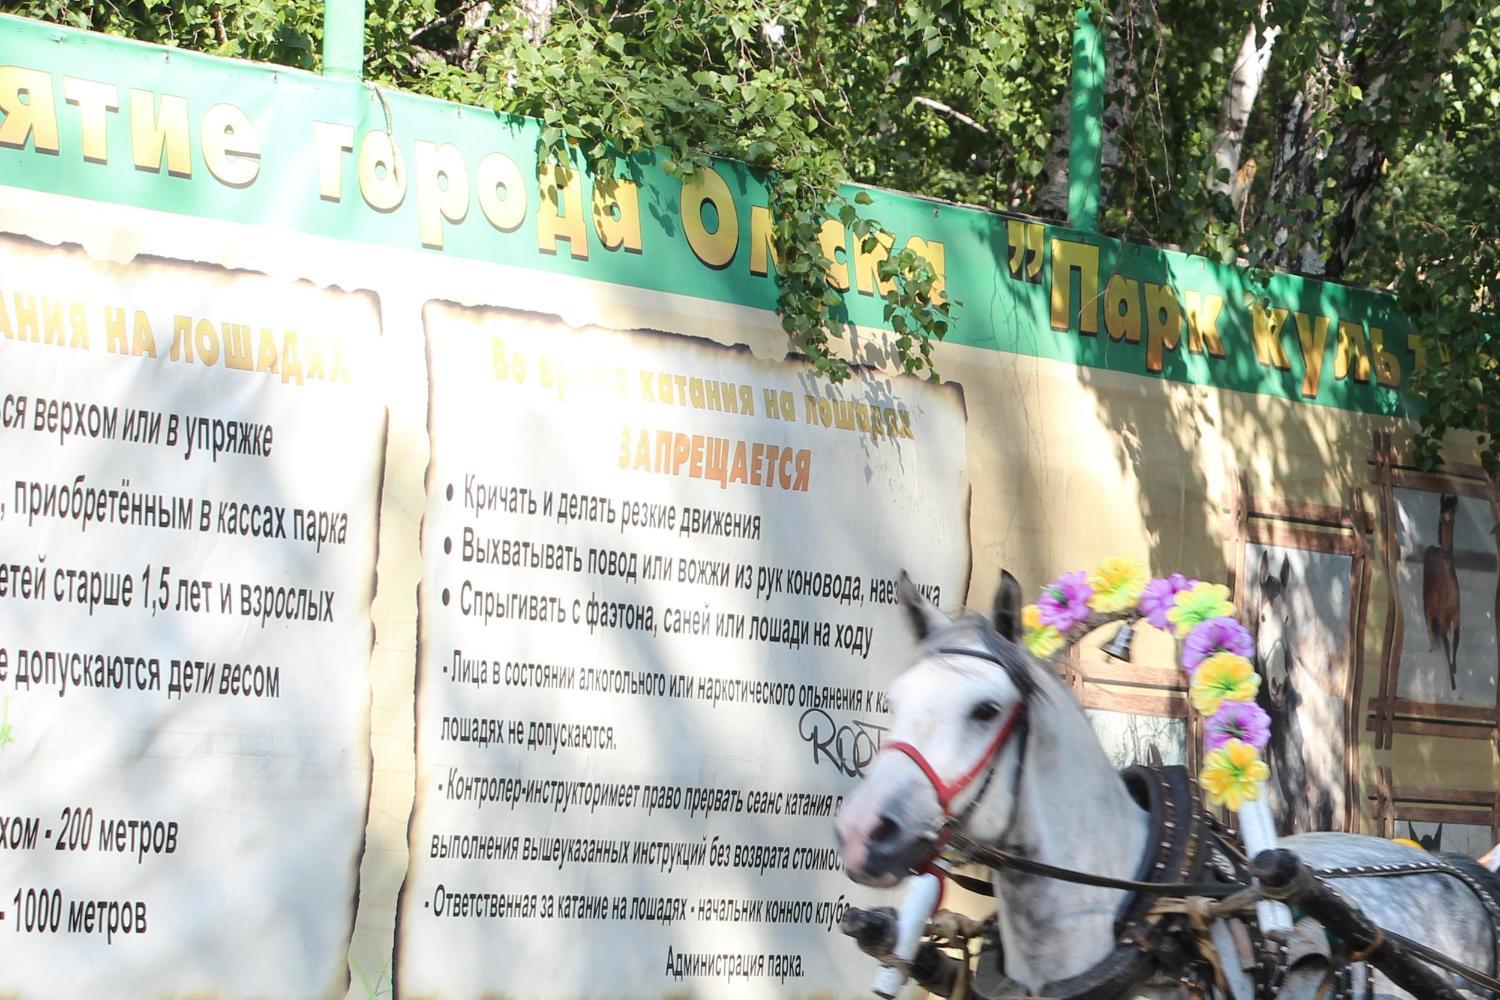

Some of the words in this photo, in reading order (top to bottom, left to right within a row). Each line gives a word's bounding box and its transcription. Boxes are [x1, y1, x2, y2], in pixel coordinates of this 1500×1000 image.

[314, 121, 643, 262] города
[104, 306, 157, 359] НА
[170, 315, 350, 386] ЛОШАДЯХ
[490, 335, 527, 384] Во
[639, 370, 755, 417] катания
[763, 388, 796, 422] на
[804, 394, 914, 442] лошадях
[33, 397, 118, 446] верхом
[122, 407, 162, 446] или
[166, 413, 179, 447] в
[184, 415, 273, 463] упряжке
[618, 425, 811, 492] ЗАПРЕЩАЕТСЯ
[15, 474, 193, 532] приобретённым
[200, 499, 212, 532] в
[217, 500, 287, 539] кассах
[293, 508, 348, 554] парка
[464, 473, 537, 518] Кричать
[543, 490, 553, 517] и
[557, 493, 615, 525] делать
[621, 500, 675, 534] резкие
[679, 507, 761, 541] движения
[54, 566, 133, 616] старше
[142, 564, 170, 617] 1,5
[175, 578, 213, 613] лет
[220, 582, 232, 614] и
[240, 584, 335, 628] взрослых
[462, 526, 582, 573] Выхватывать
[588, 548, 637, 584] повод
[642, 553, 673, 581] или
[678, 557, 729, 588] вожжи
[735, 565, 752, 589] из
[757, 565, 783, 600] рук
[787, 569, 864, 607] коновода,
[460, 579, 566, 625] Спрыгивать
[572, 597, 581, 624] с
[586, 592, 657, 638] фаэтона,
[663, 603, 711, 637] саней
[716, 612, 744, 639] или
[750, 615, 808, 650] лошади
[813, 619, 830, 647] на
[834, 622, 873, 659] ходу
[15, 649, 161, 697] допускаются
[168, 660, 216, 700] дети
[219, 663, 280, 698] весом
[451, 650, 487, 689] Лица
[493, 660, 500, 685] в
[505, 661, 575, 690] состоянии
[579, 667, 666, 698] алкогольного
[669, 673, 694, 699] или
[697, 674, 795, 708] наркотического
[799, 684, 862, 712] опьянения
[866, 690, 873, 713] к
[441, 716, 504, 749] лошадях
[508, 718, 524, 745] не
[528, 720, 616, 755] допускаются.
[641, 784, 681, 816] право
[684, 787, 743, 818] прервать
[746, 790, 782, 815] сеанс
[784, 792, 832, 817] катания
[55, 807, 93, 851] 200
[99, 819, 178, 864] метров
[430, 833, 519, 861] выполнения
[522, 836, 629, 870] вышеуказанных
[632, 834, 707, 873] инструкций
[709, 836, 730, 867] без
[733, 843, 790, 875] возврата
[13, 888, 62, 933] 1000
[68, 900, 147, 944] метров
[433, 883, 537, 918] Ответственная
[540, 895, 553, 919] за
[558, 894, 608, 919] катание
[611, 896, 627, 920] на
[629, 895, 687, 926] лошадях
[698, 898, 763, 923] начальник
[765, 900, 812, 924] конного
[665, 945, 764, 985] Администрация
[767, 955, 805, 985] парка.
